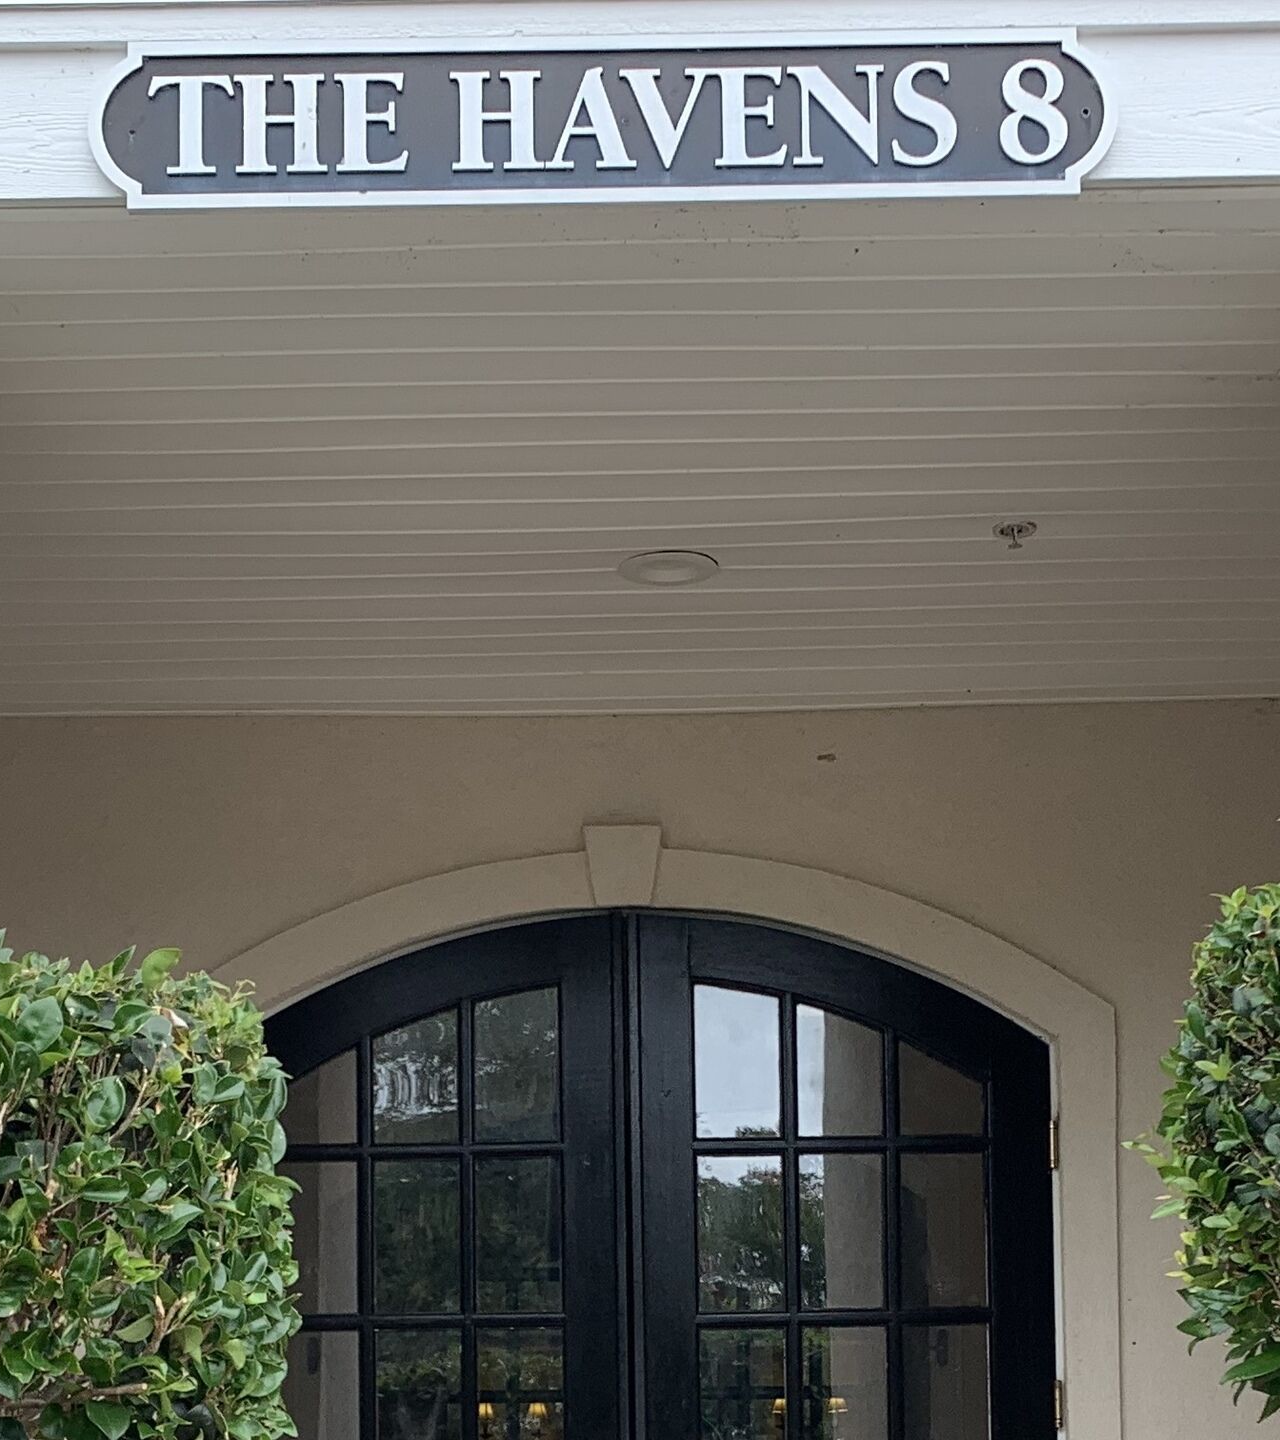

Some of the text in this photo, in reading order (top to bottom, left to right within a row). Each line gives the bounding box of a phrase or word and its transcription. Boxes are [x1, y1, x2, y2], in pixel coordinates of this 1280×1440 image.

[147, 59, 1069, 176] THE HAVENS 8
